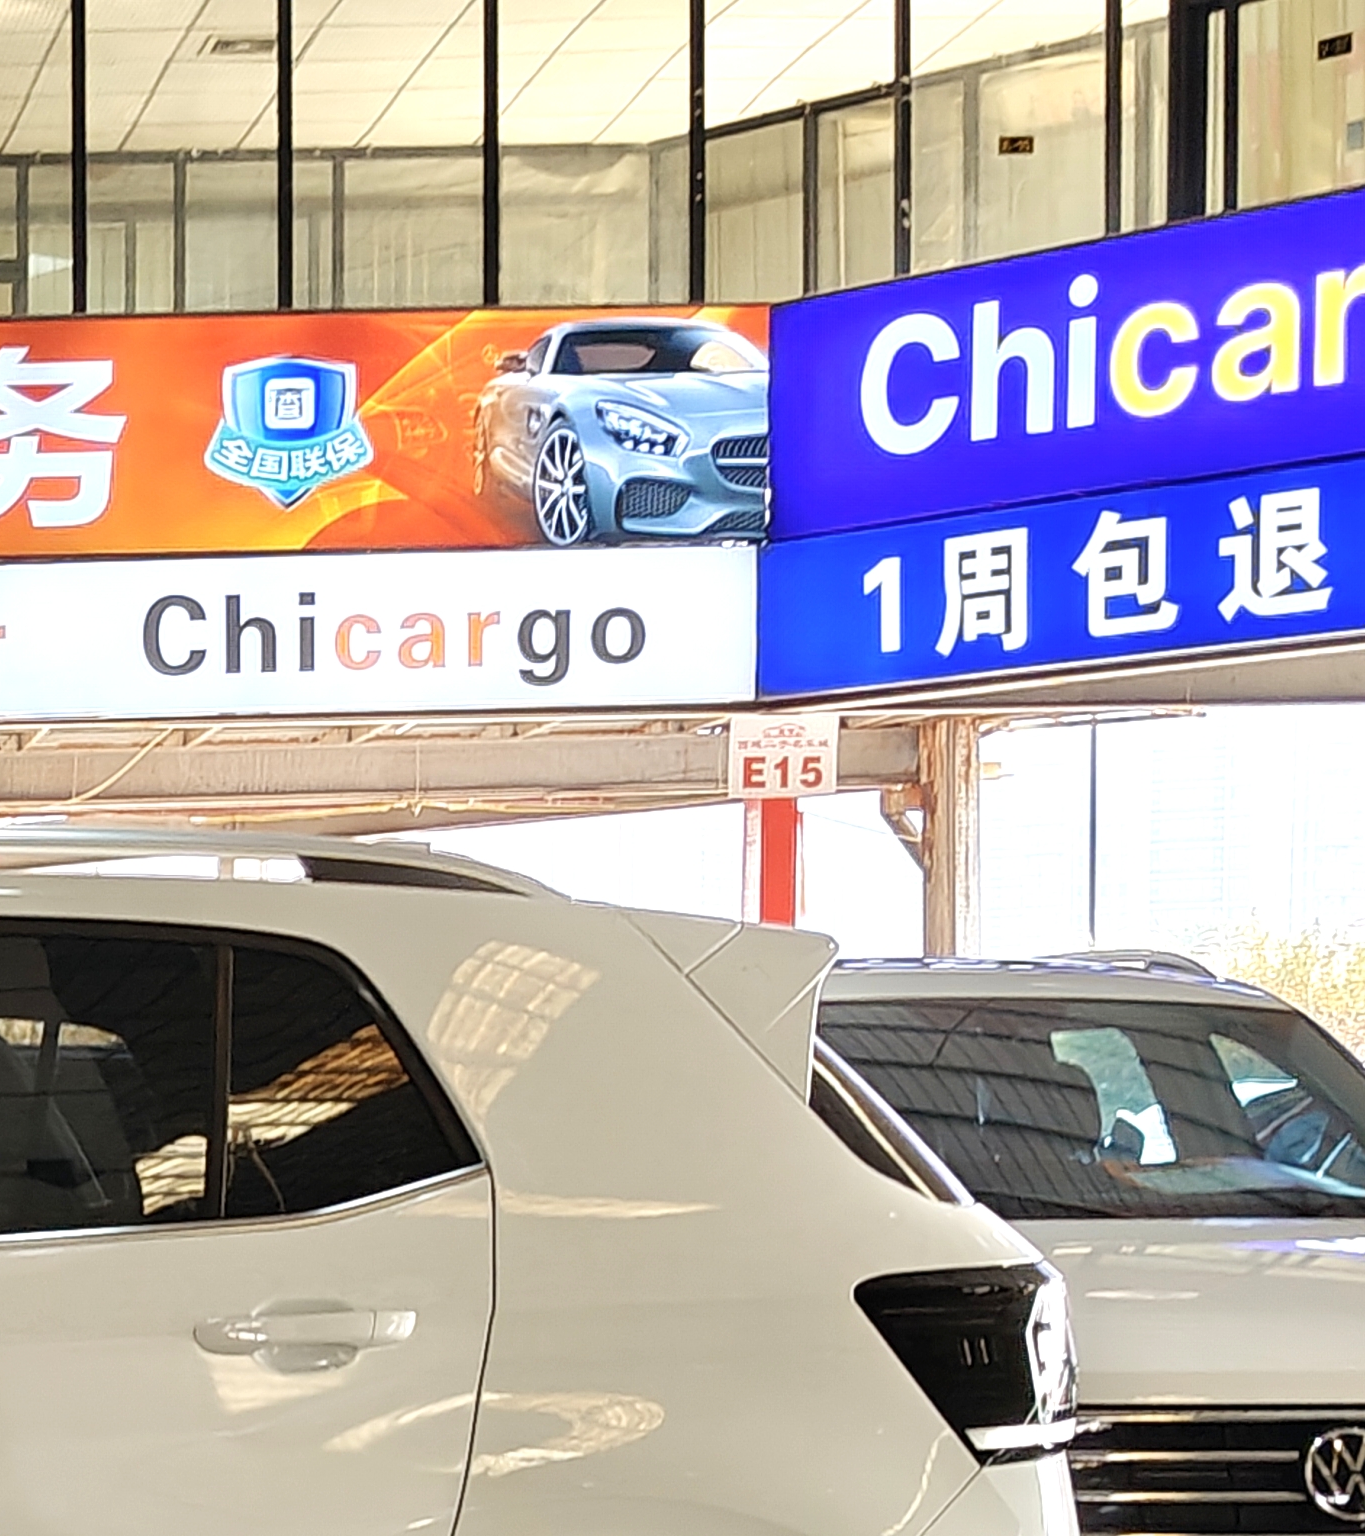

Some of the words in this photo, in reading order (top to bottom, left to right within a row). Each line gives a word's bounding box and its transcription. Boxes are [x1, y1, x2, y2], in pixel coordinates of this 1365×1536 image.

[213, 431, 367, 482] 全国联保
[862, 487, 1334, 658] 1周包退
[141, 590, 648, 688] Chicargo
[742, 755, 823, 789] E15
